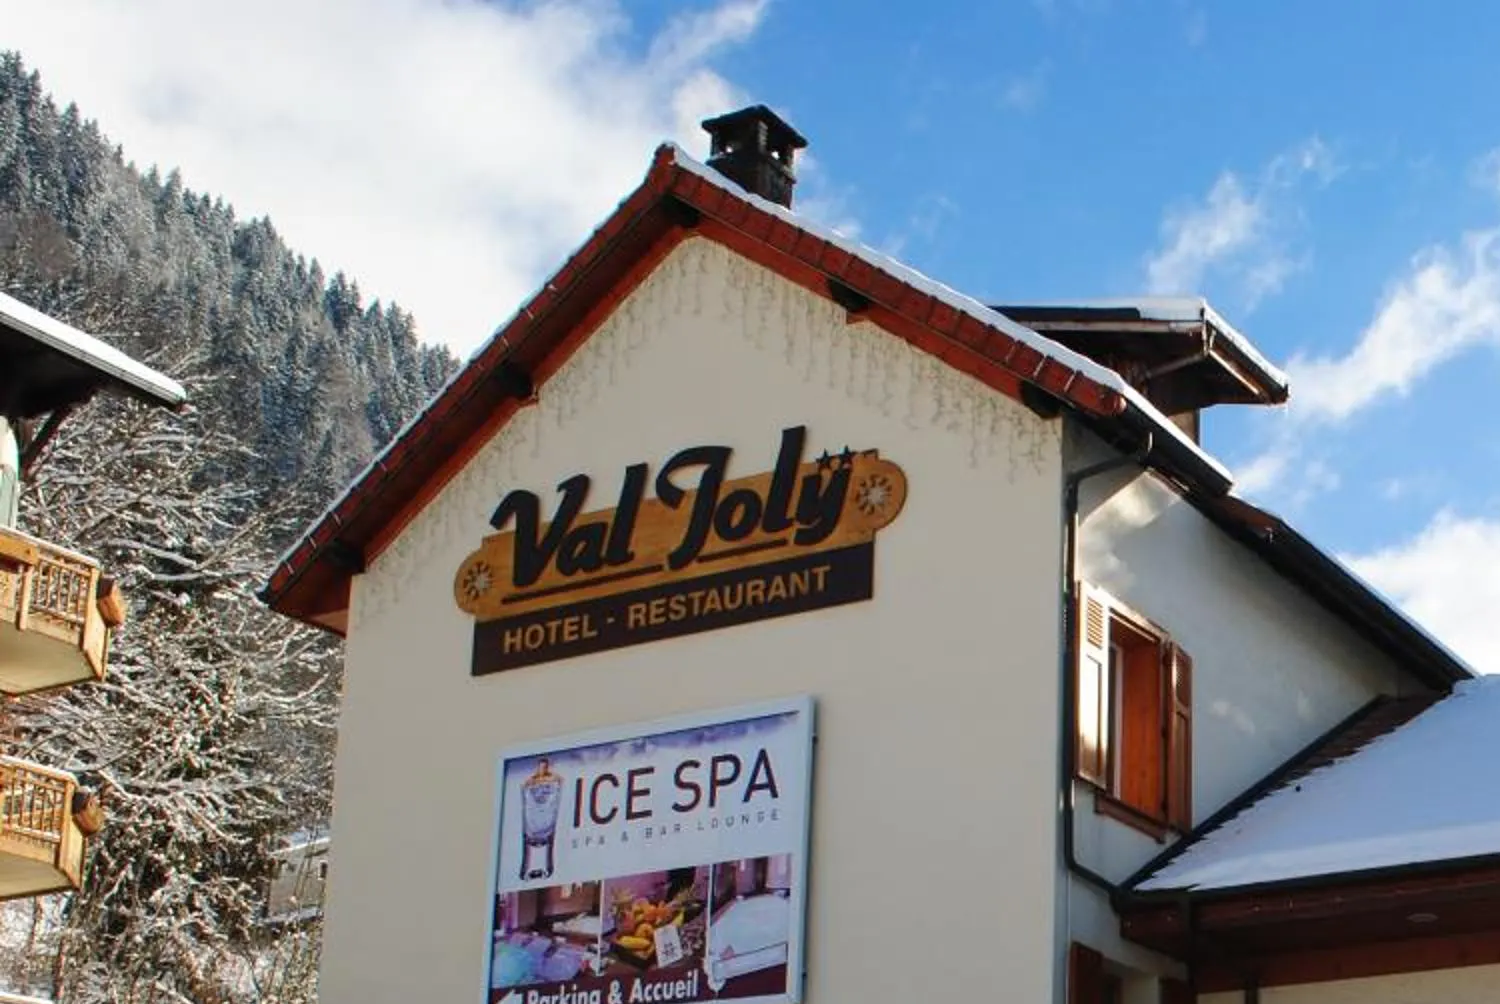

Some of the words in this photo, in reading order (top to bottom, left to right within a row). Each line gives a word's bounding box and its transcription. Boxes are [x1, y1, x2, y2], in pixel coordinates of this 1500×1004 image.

[490, 462, 648, 587] Val
[656, 425, 854, 571] Joly
[504, 615, 598, 653] HOTEL
[628, 566, 831, 629] RESTAURANT
[573, 766, 655, 828] ICE
[672, 748, 779, 813] SPA
[645, 823, 681, 840] BAR
[697, 808, 780, 832] LOUNGE
[629, 970, 699, 1004] Accueil
